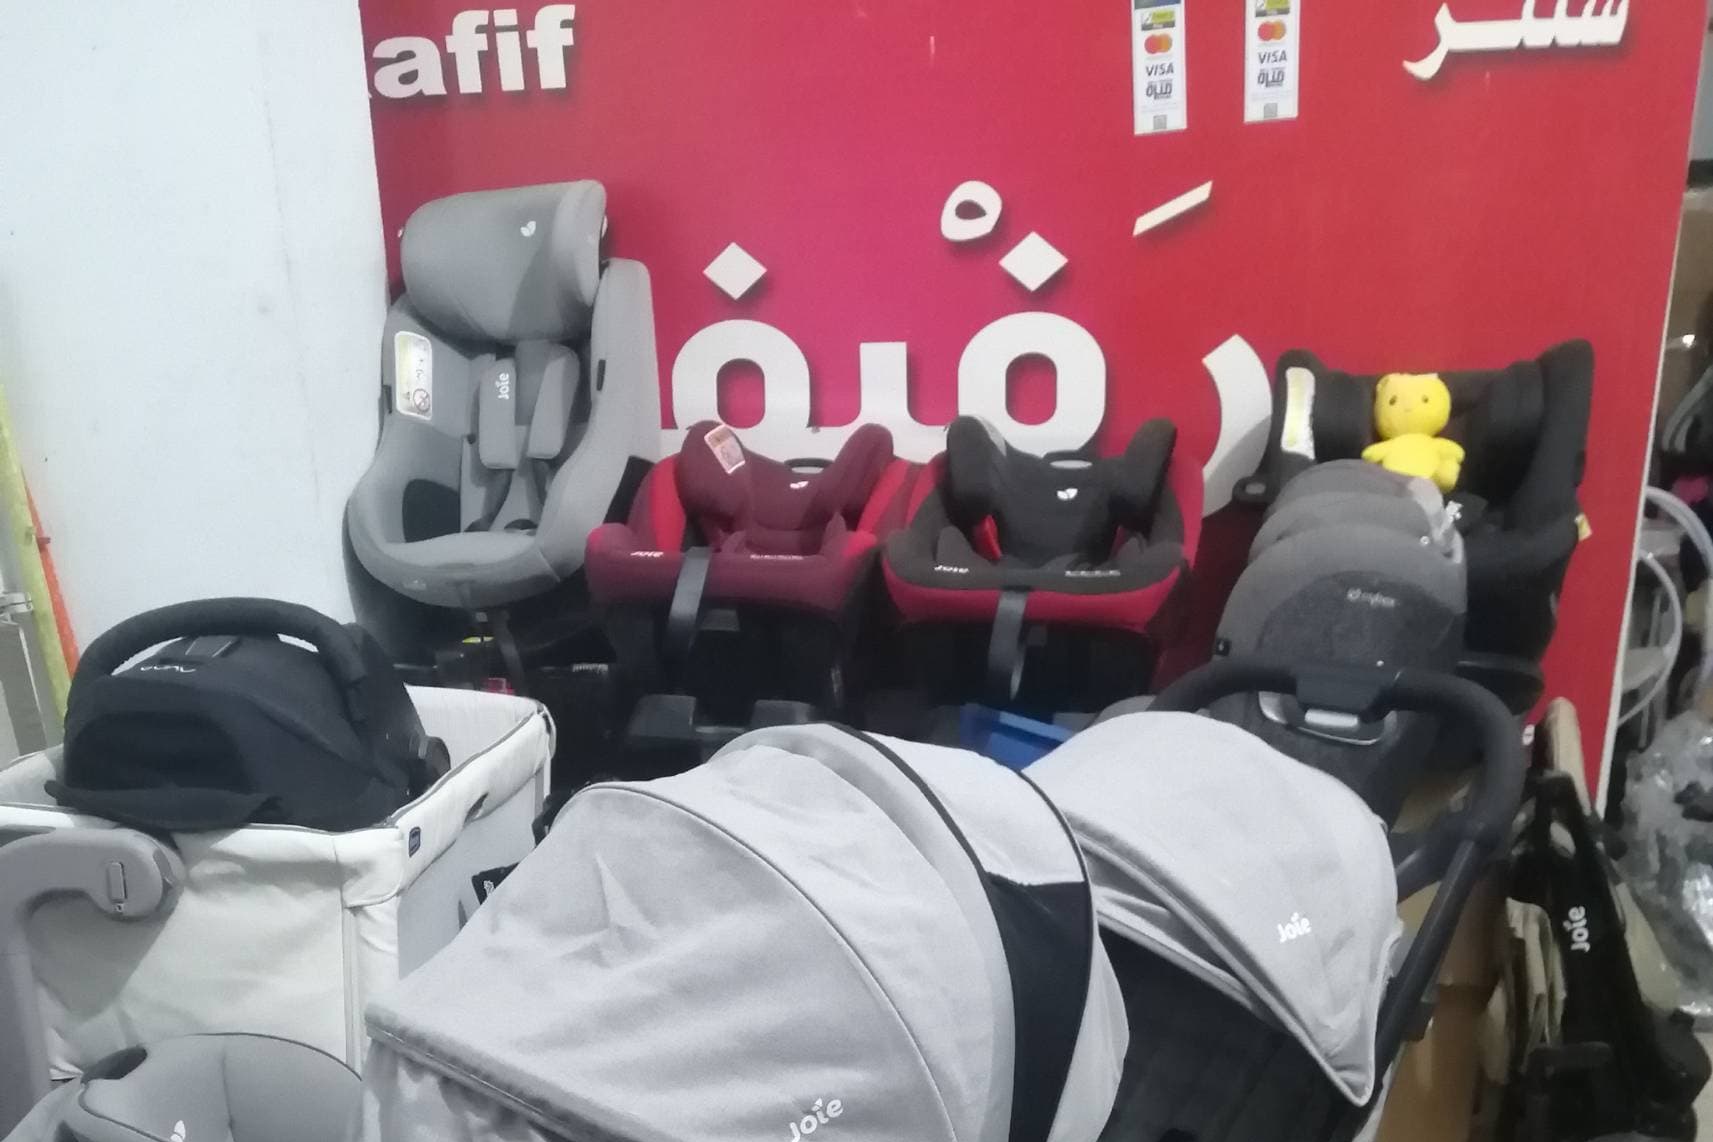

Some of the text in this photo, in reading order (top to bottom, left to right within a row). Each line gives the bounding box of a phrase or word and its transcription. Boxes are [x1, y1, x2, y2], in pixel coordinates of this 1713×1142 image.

[368, 4, 576, 99] afif
[1146, 62, 1174, 76] VISA
[1258, 50, 1287, 64] VISA
[495, 346, 510, 400] Joie
[1277, 912, 1312, 943] Joie
[1562, 905, 1590, 953] Joie
